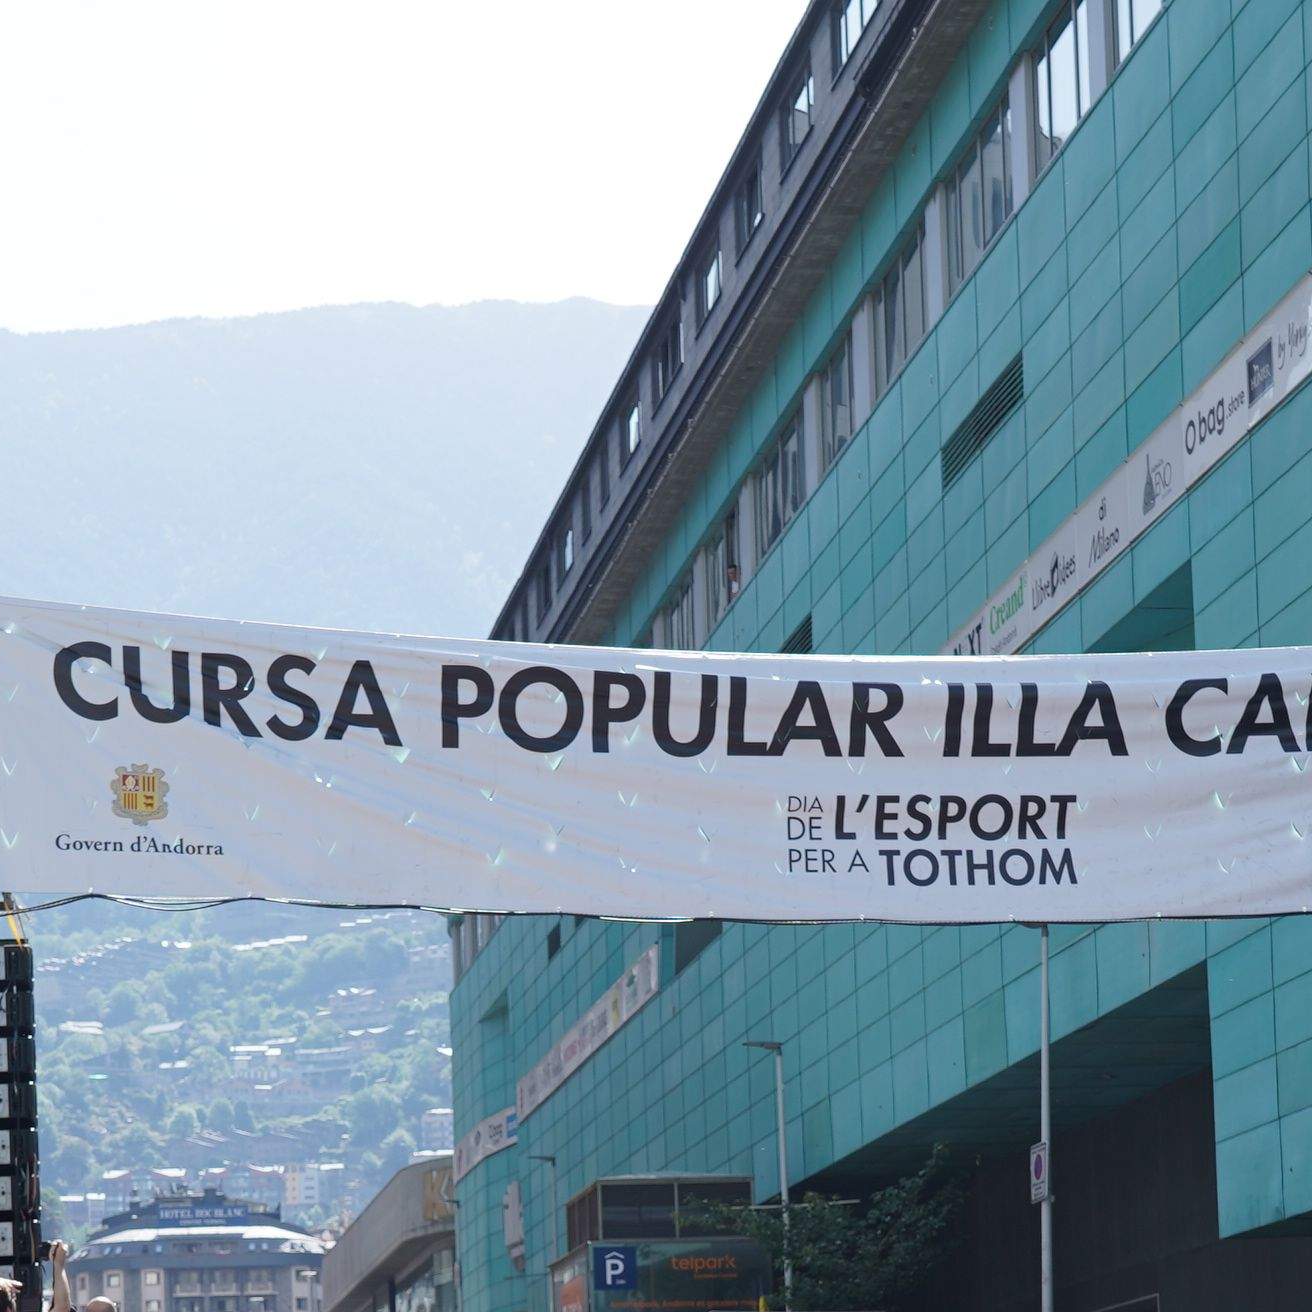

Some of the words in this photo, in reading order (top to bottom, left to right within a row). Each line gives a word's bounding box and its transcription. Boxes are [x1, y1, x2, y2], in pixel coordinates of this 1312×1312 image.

[1198, 397, 1225, 446] bag
[52, 640, 403, 748] CURSA
[440, 664, 905, 758] POPULAR
[943, 680, 1129, 757] ILLA
[787, 796, 824, 813] DIA
[787, 816, 823, 841] DE
[835, 794, 1077, 841] L'ESPORT
[55, 833, 124, 852] Govern
[130, 836, 225, 856] d'Andorra
[788, 849, 837, 873] PER
[848, 849, 870, 873] A
[878, 848, 1078, 887] TOTHOM
[671, 1254, 736, 1272] telpark
